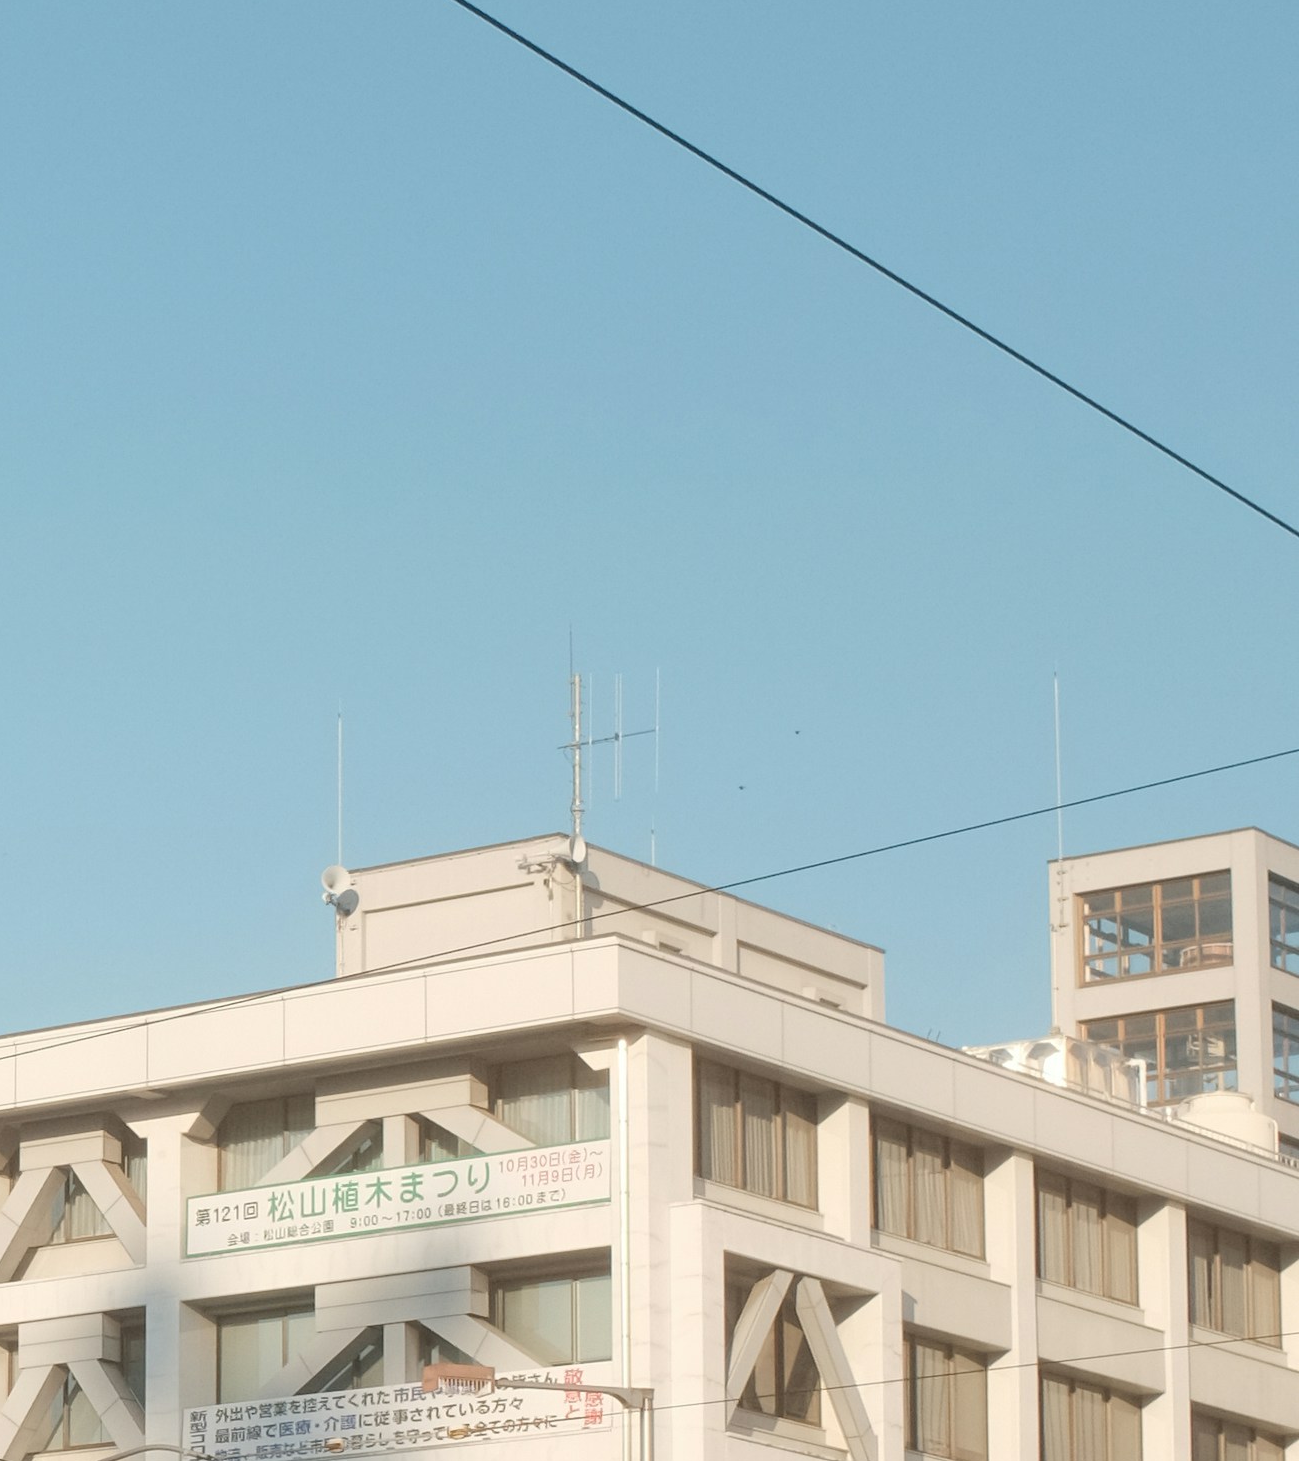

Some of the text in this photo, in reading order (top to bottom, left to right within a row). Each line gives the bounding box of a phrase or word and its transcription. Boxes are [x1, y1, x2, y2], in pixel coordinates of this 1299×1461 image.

[195, 1161, 490, 1226] 第121回 松山植木まつり
